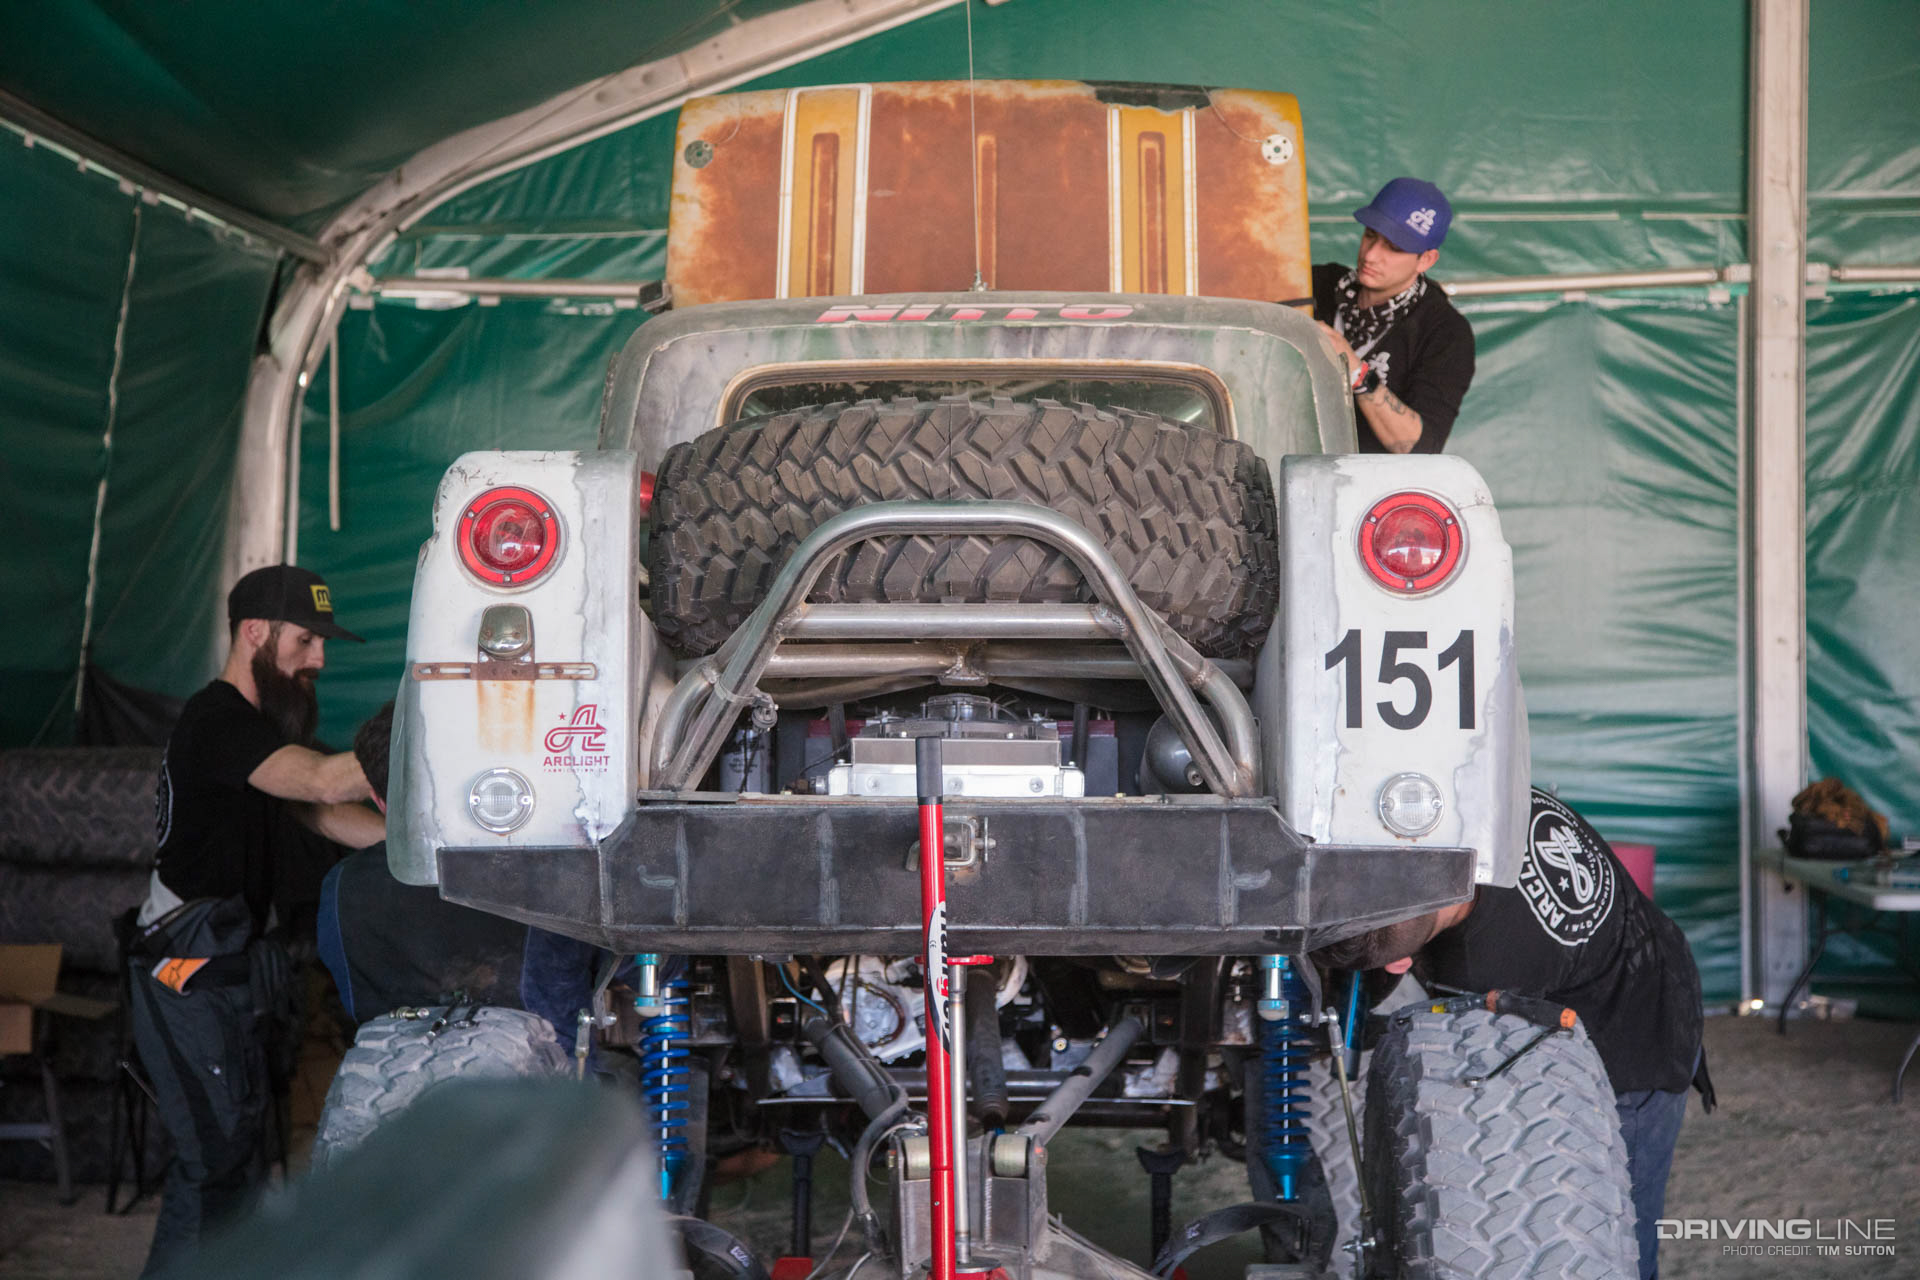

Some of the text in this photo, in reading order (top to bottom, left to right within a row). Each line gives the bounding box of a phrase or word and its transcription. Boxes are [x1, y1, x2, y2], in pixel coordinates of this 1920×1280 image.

[816, 303, 1135, 323] NITTO
[1325, 629, 1475, 731] 151
[543, 755, 610, 767] ARCLIGHT
